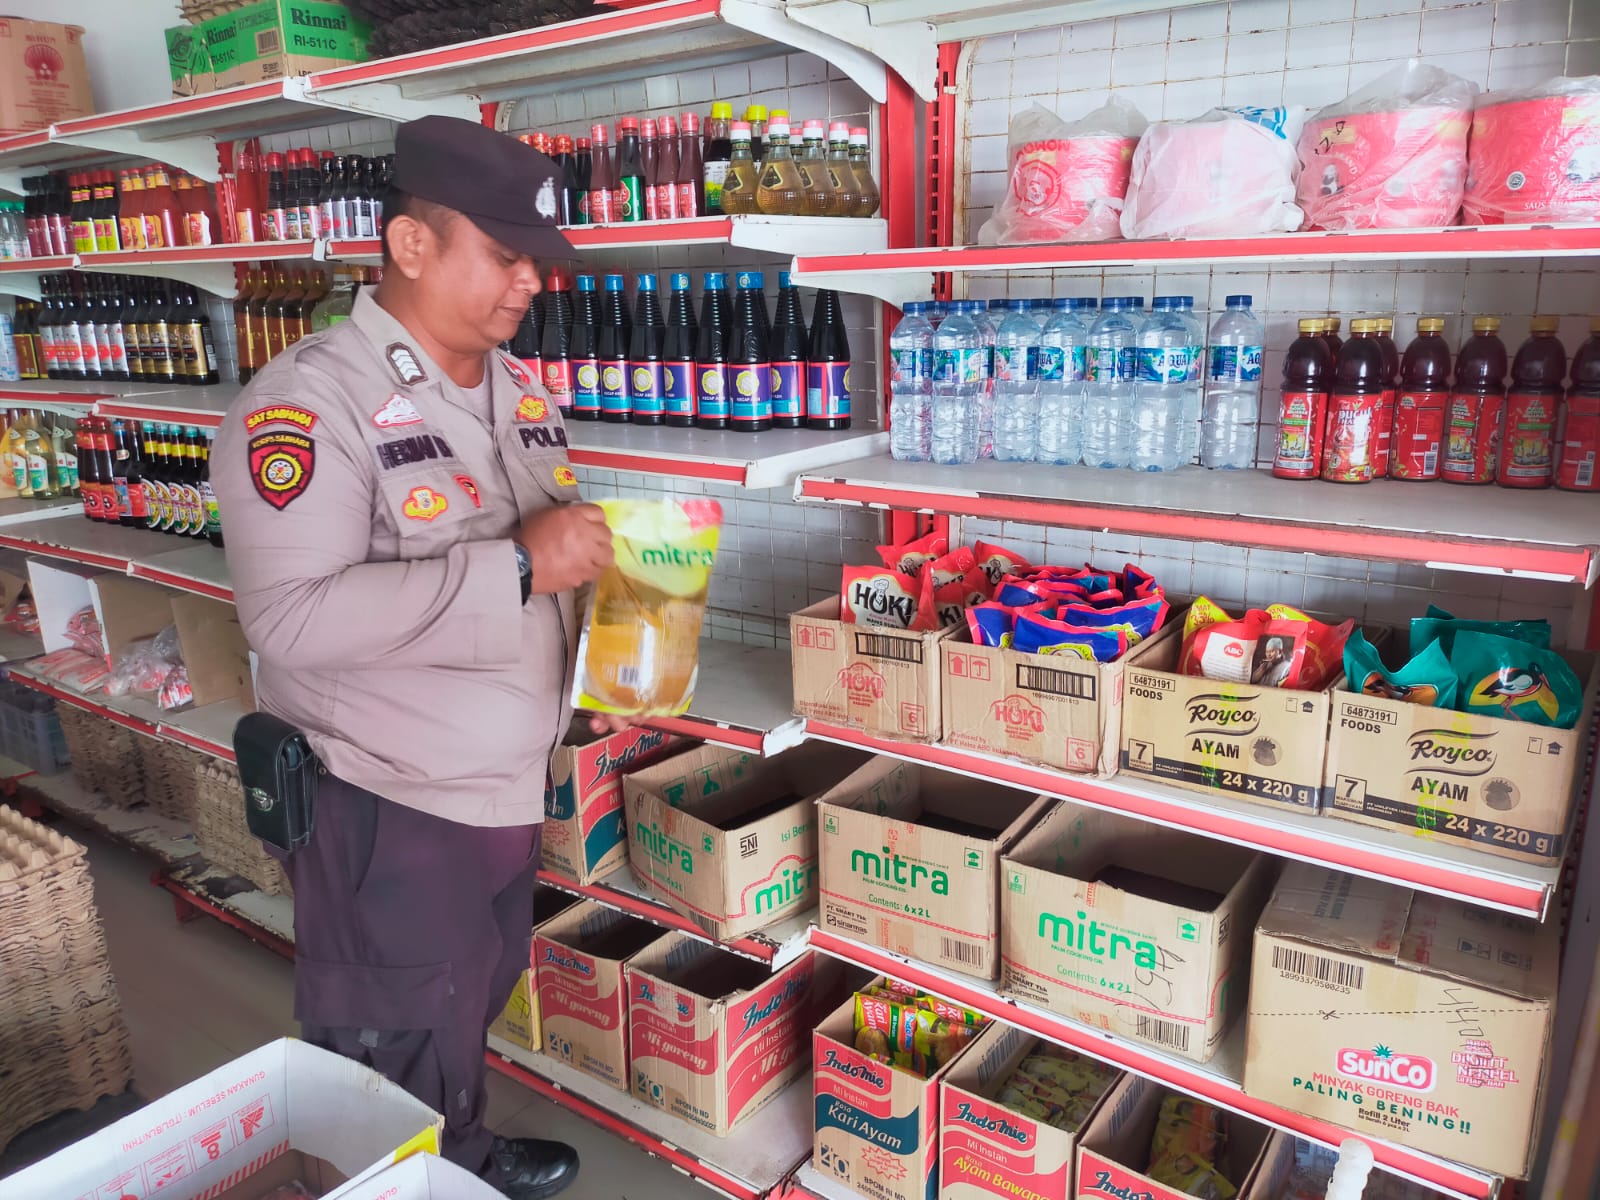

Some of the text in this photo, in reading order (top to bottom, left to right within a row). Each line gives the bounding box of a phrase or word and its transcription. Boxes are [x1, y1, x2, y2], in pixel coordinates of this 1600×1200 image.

[291, 7, 348, 31] Rinnai
[294, 34, 337, 50] RI-511C
[1158, 354, 1187, 368] AQUA
[248, 411, 265, 428] SAT
[641, 543, 715, 567] mitra
[1224, 646, 1243, 656] ABC
[1129, 686, 1163, 701] FOODS
[1134, 675, 1171, 689] 64873191
[1187, 703, 1257, 726] Royco
[1347, 705, 1391, 723] 64873191
[1341, 718, 1382, 734] FOODS
[1075, 747, 1086, 760] 6
[1135, 742, 1147, 760] 7
[1191, 738, 1240, 759] AYAM
[1410, 739, 1493, 764] Royco
[1222, 771, 1309, 803] 24 x 220 g
[1344, 779, 1358, 798] 7
[1411, 776, 1469, 802] AYAM
[740, 835, 758, 854] SNI
[1445, 814, 1549, 854] 24 x 220 g
[636, 822, 693, 875] mitra
[851, 846, 949, 896] mitra
[1014, 874, 1020, 884] 6
[755, 865, 818, 915] mitr
[1038, 910, 1157, 971] mitra
[569, 1000, 611, 1027] goreng
[662, 1041, 708, 1071] goreng
[1342, 1051, 1427, 1086] SunCo
[227, 1070, 266, 1095] GUNAKAN
[1292, 1076, 1363, 1105] PALING
[188, 1090, 226, 1117] SEBELUM
[835, 1099, 852, 1113] Rasa
[845, 1089, 869, 1109] Instan
[1312, 1071, 1460, 1118] MINYAK GORENG BAIK
[828, 1104, 902, 1150] Kari Ayam
[1358, 1107, 1411, 1128] Refill 2 Liter
[207, 1141, 220, 1160] 8
[965, 1154, 983, 1168] Rasa
[967, 1138, 1008, 1164] Mi Instan
[953, 1156, 991, 1183] Ayam
[863, 1176, 884, 1191] BPOM
[885, 1187, 893, 1197] RI
